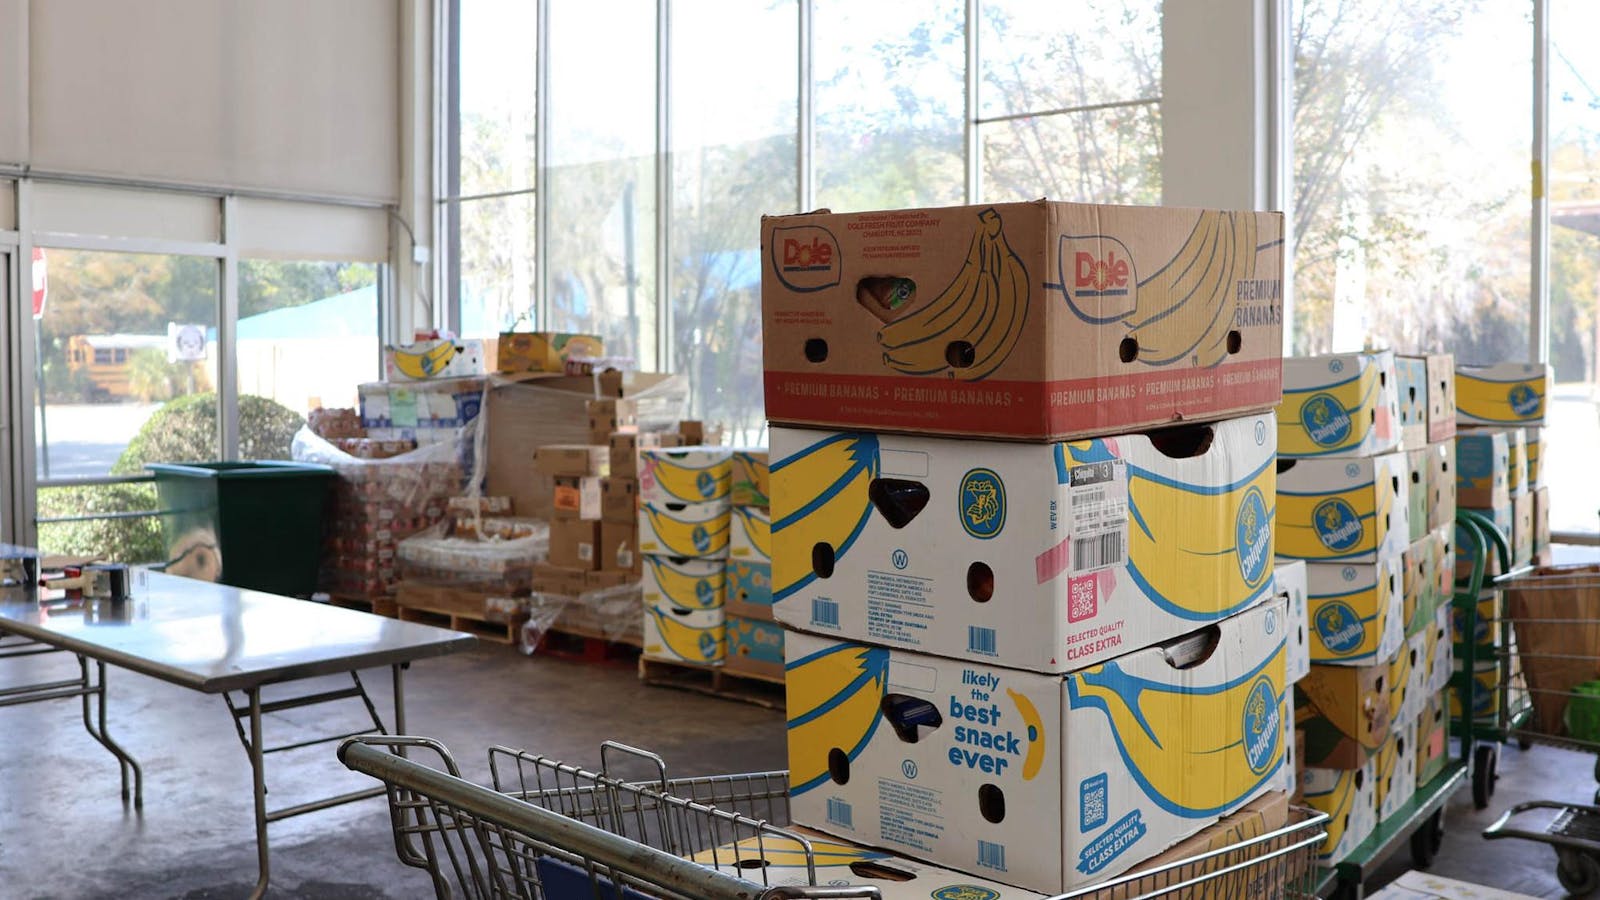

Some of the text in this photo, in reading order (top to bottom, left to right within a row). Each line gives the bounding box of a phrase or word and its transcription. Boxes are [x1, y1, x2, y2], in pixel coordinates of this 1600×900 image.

[783, 237, 833, 266] Dole
[1075, 251, 1129, 290] Dole
[1236, 279, 1281, 301] PREMIUM
[1235, 304, 1281, 327] BANANAS
[784, 382, 1013, 407] PREMIUM BANANAS PREMIUM BANANAS
[1050, 388, 1095, 407] PREMIUM
[1097, 384, 1137, 402] BANANAS
[1145, 380, 1181, 396] PREMIUM
[1181, 375, 1215, 392] BANANAS
[1310, 413, 1351, 443] Chiquita
[1102, 464, 1109, 478] 3
[1050, 500, 1057, 511] BX
[1321, 518, 1361, 548] Chiquita
[893, 552, 907, 567] W
[1241, 523, 1271, 580] Chiquita
[1066, 620, 1125, 645] SELECTED QUALITY
[1323, 622, 1364, 649] Chiquita
[1067, 634, 1122, 661] CLASS EXTRA
[962, 669, 1000, 692] likely
[971, 688, 990, 702] the
[950, 695, 1002, 727] best
[954, 725, 1020, 756] snack
[1248, 707, 1280, 770] Chiquita
[903, 762, 917, 777] W
[948, 746, 1009, 776] ever
[1084, 813, 1139, 859] SELECTED QUALITY
[1088, 826, 1140, 870] CLASS EXTRA
